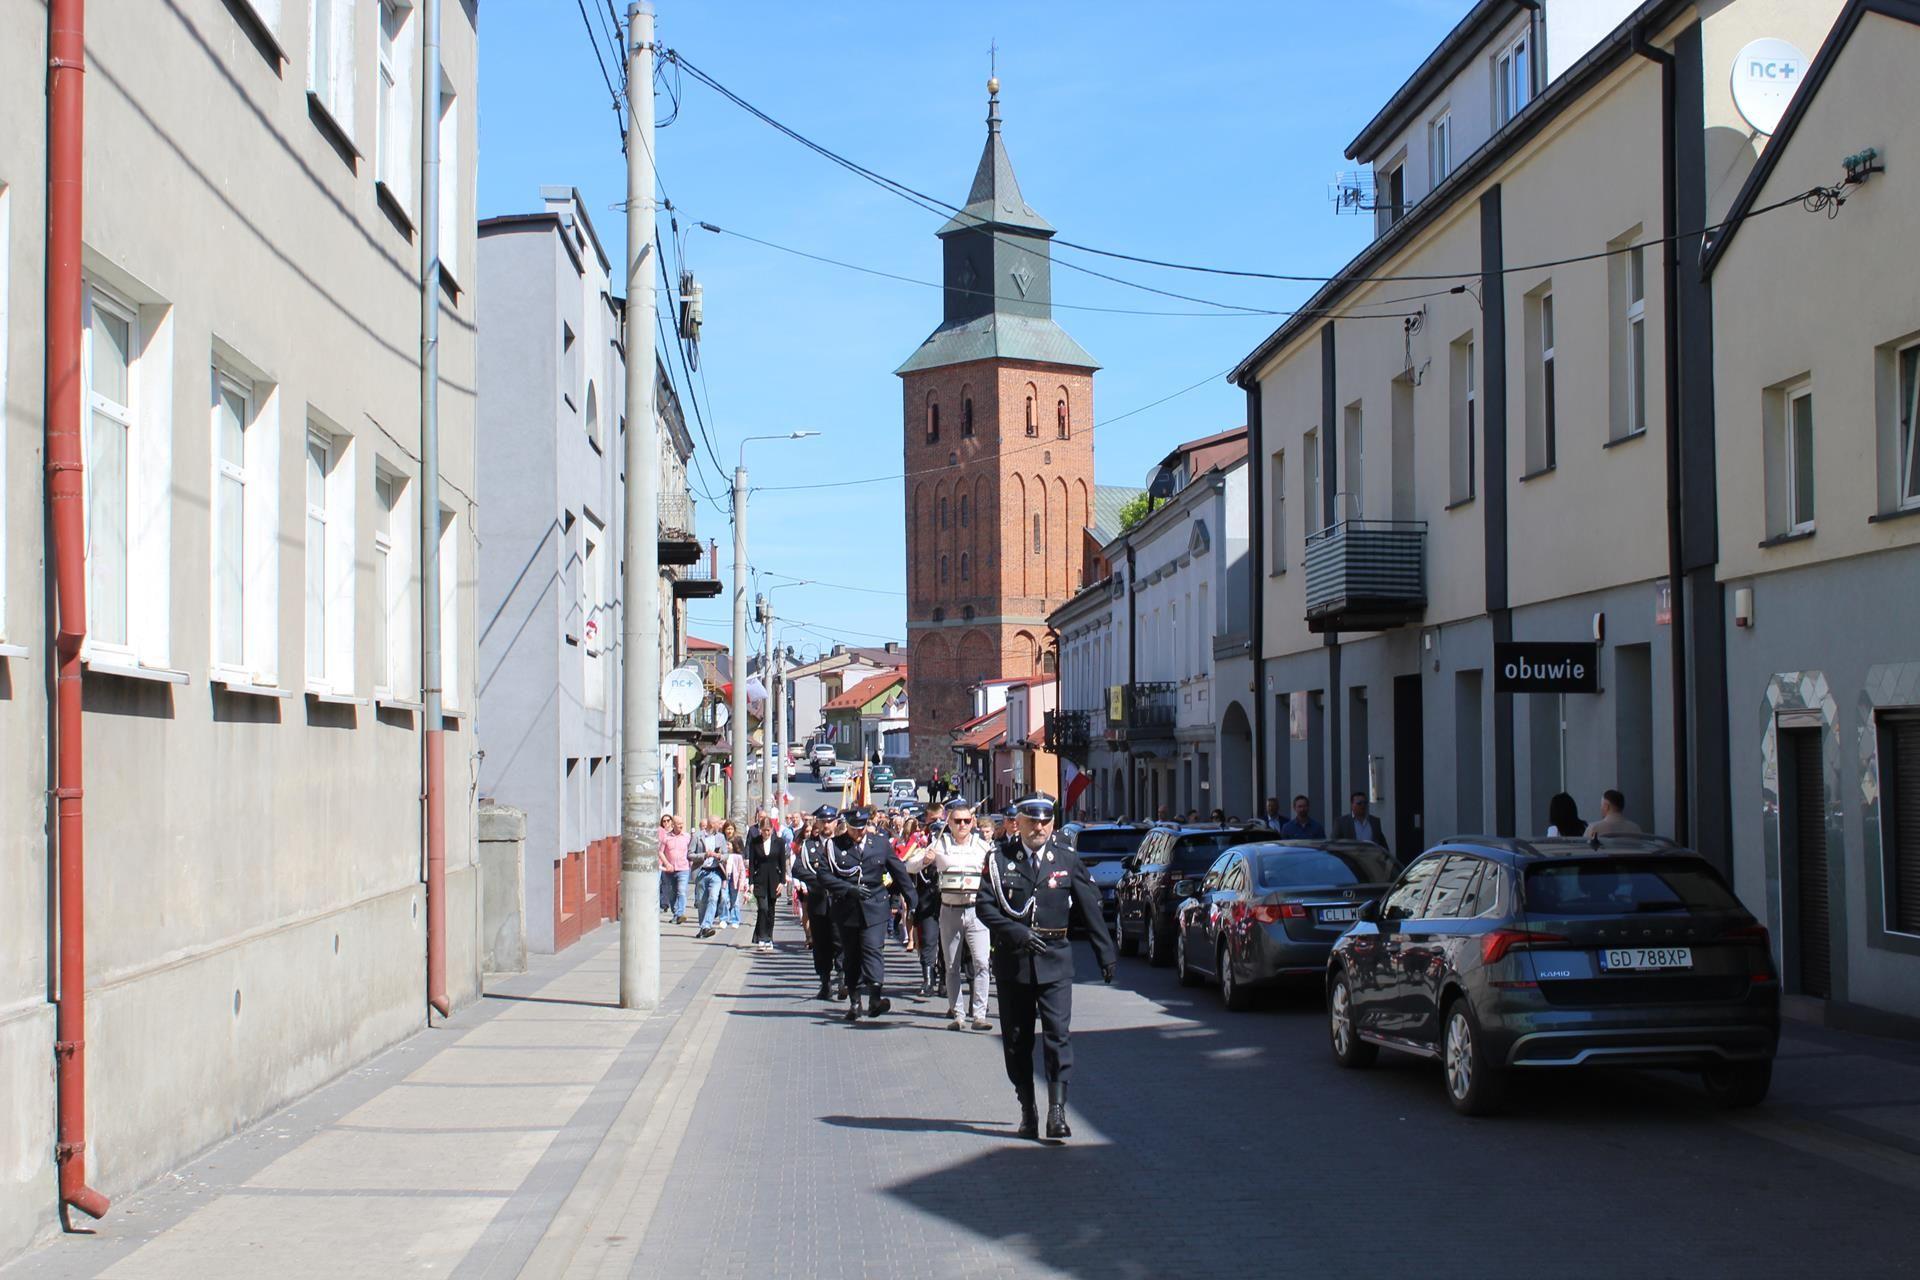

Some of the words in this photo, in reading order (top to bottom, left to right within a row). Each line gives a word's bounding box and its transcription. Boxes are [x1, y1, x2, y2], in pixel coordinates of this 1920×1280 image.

[1750, 62, 1794, 79] nc+
[1505, 656, 1585, 679] obuwie
[671, 679, 694, 688] nc+
[1610, 951, 1632, 967] GD
[1637, 949, 1687, 966] 788XP
